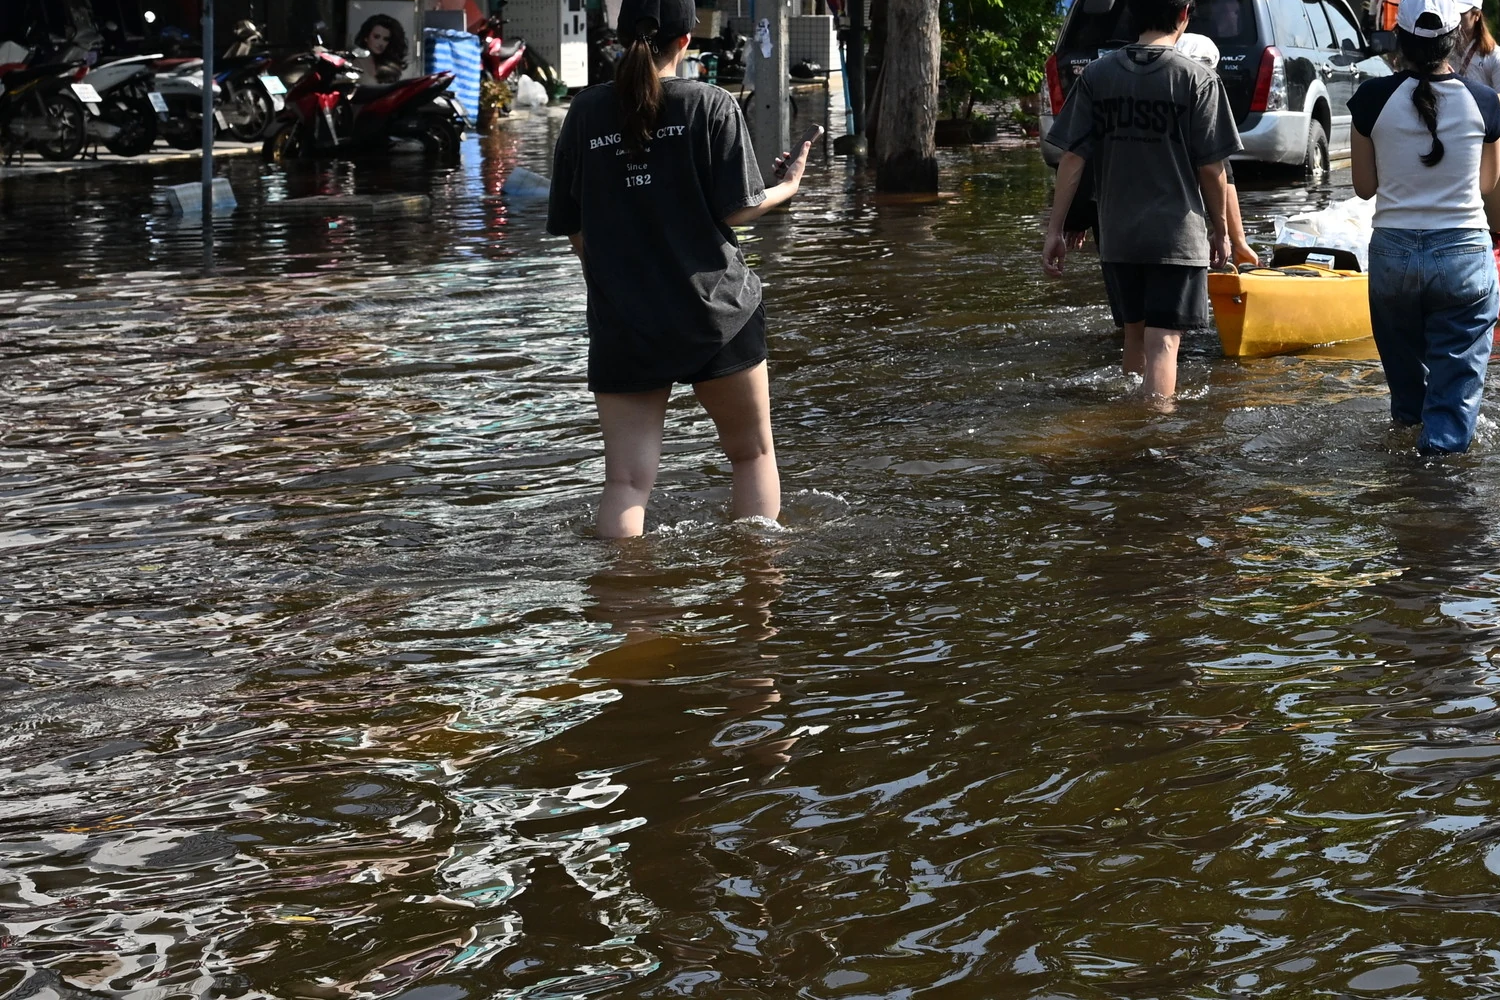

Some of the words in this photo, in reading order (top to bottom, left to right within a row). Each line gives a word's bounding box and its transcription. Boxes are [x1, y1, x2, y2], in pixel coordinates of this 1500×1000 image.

[656, 125, 685, 139] CITY
[626, 162, 648, 171] Since
[625, 173, 652, 188] 1782
